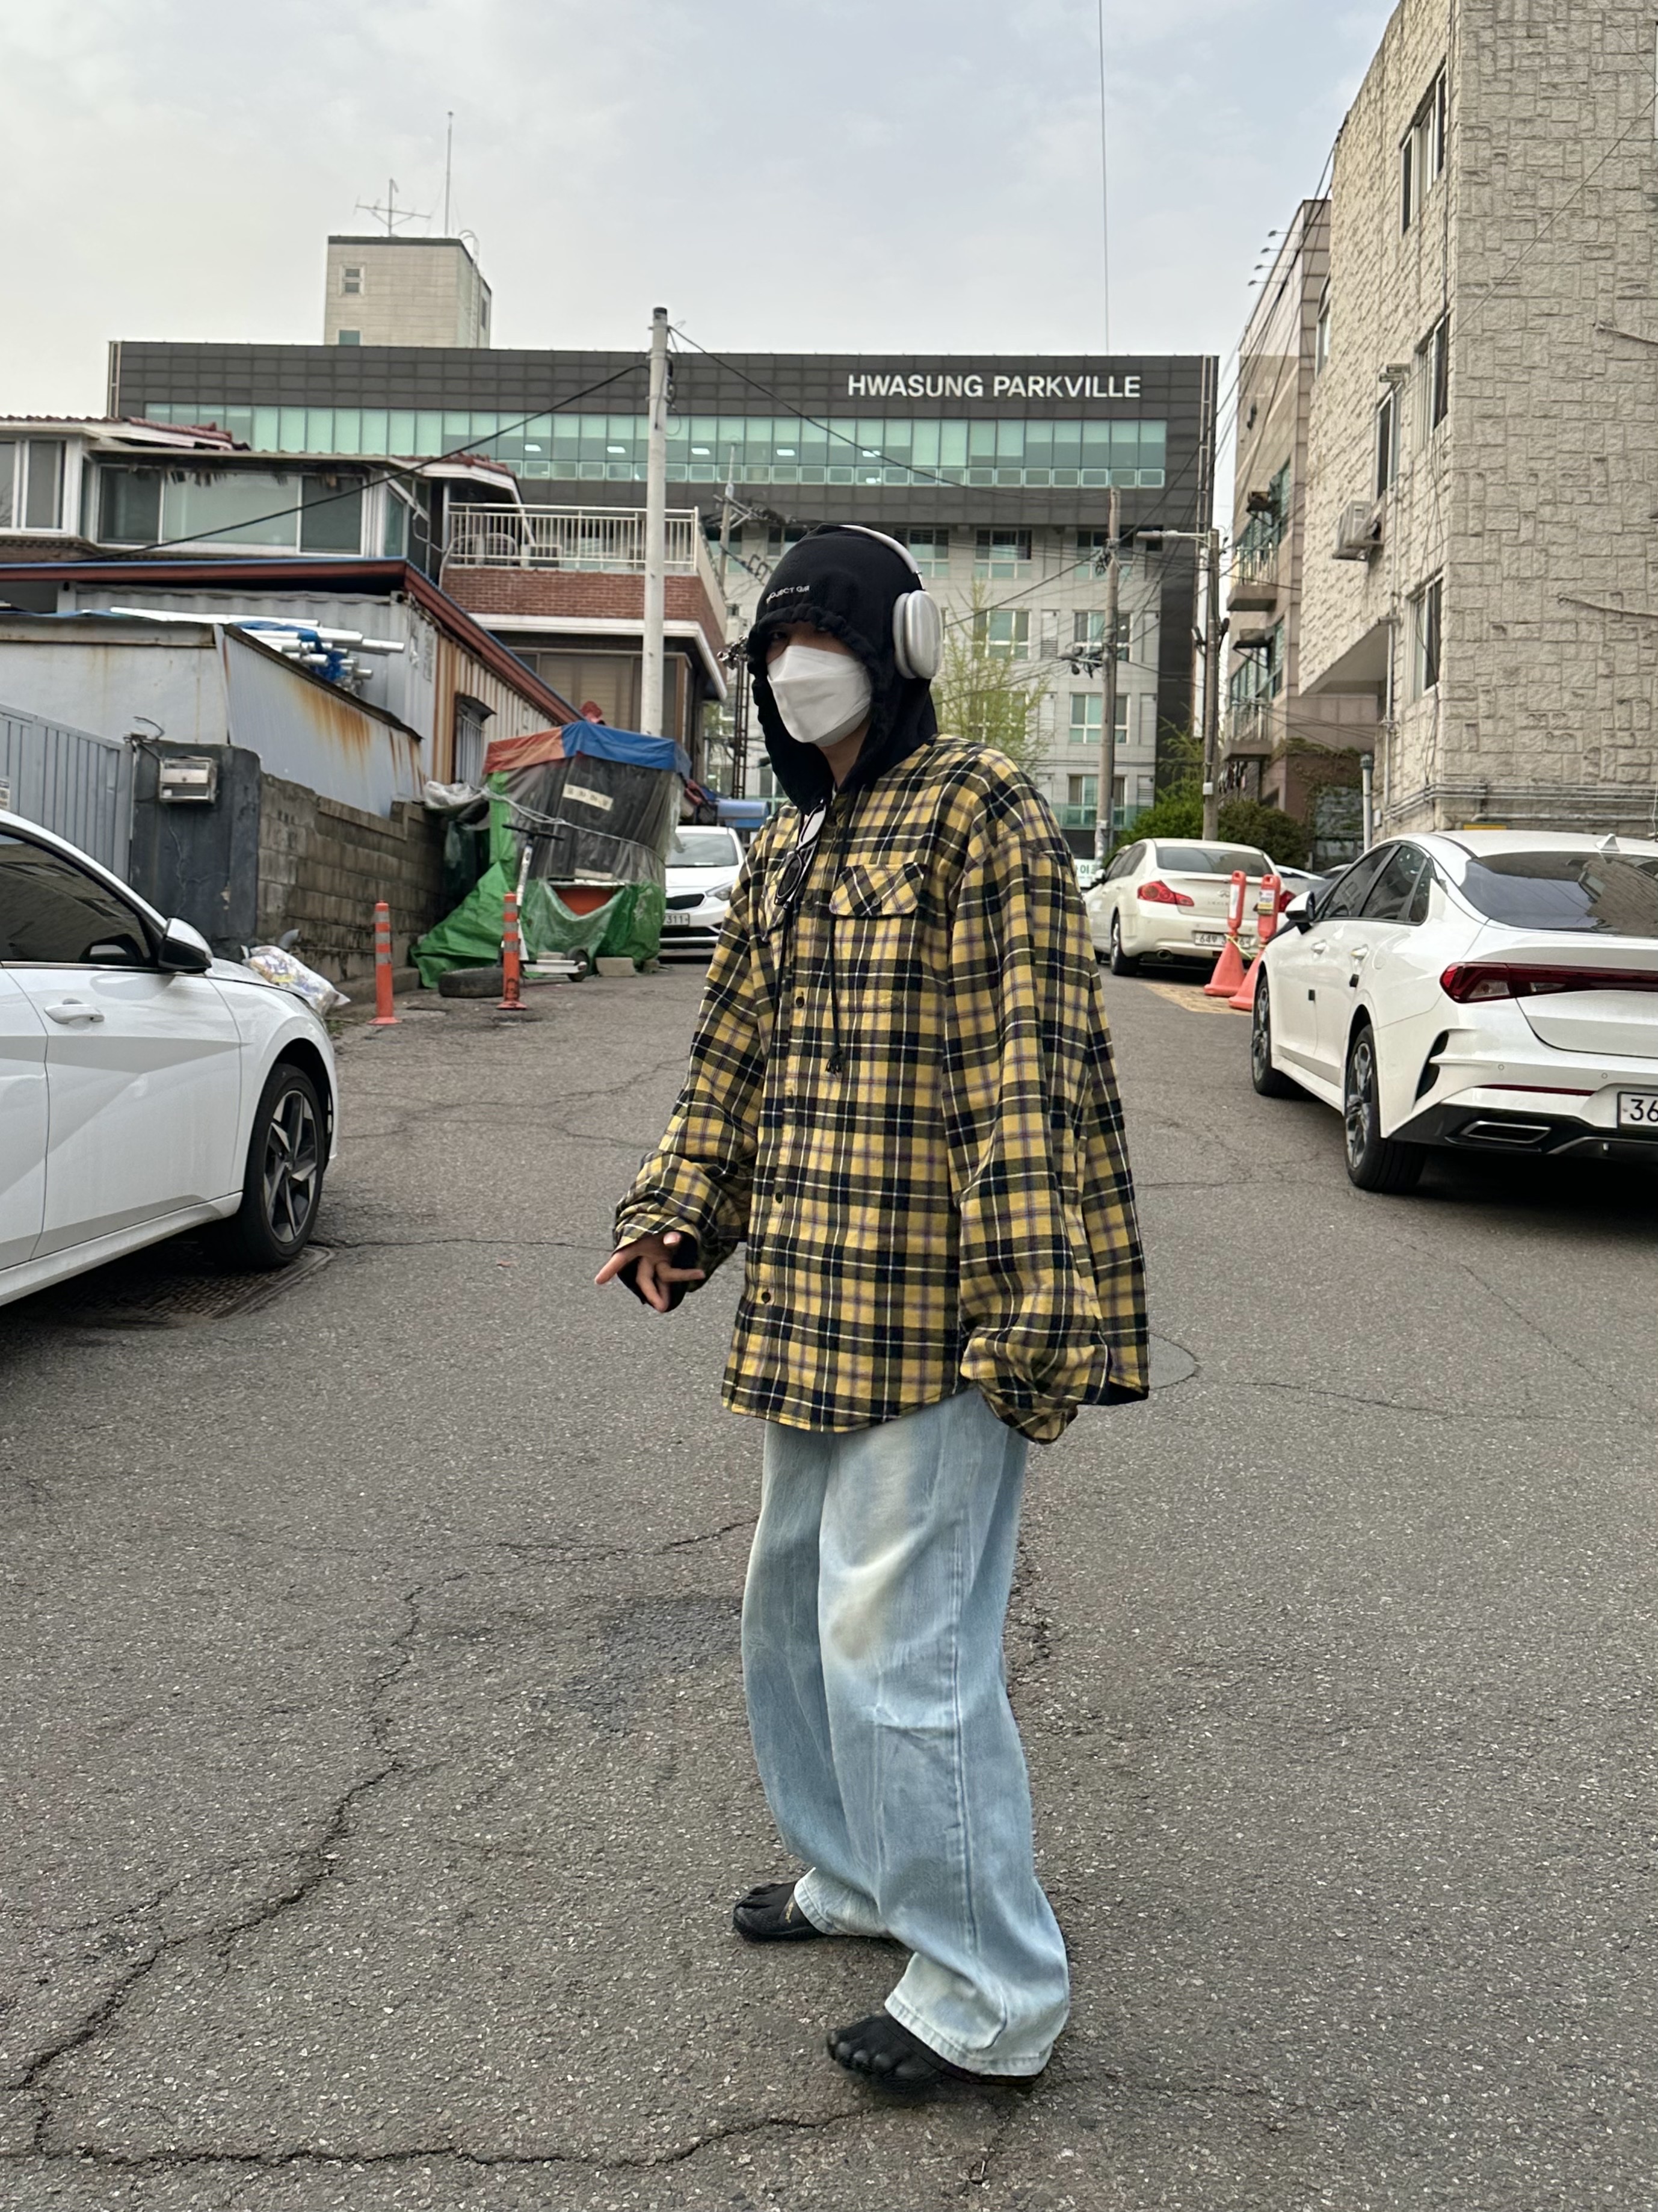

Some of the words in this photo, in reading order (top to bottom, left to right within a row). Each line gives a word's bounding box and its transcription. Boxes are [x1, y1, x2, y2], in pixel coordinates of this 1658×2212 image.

[848, 374, 983, 397] HWASUNG
[993, 375, 1141, 398] PARKVILLE
[664, 915, 683, 924] 311
[1630, 1099, 1658, 1122] 36
